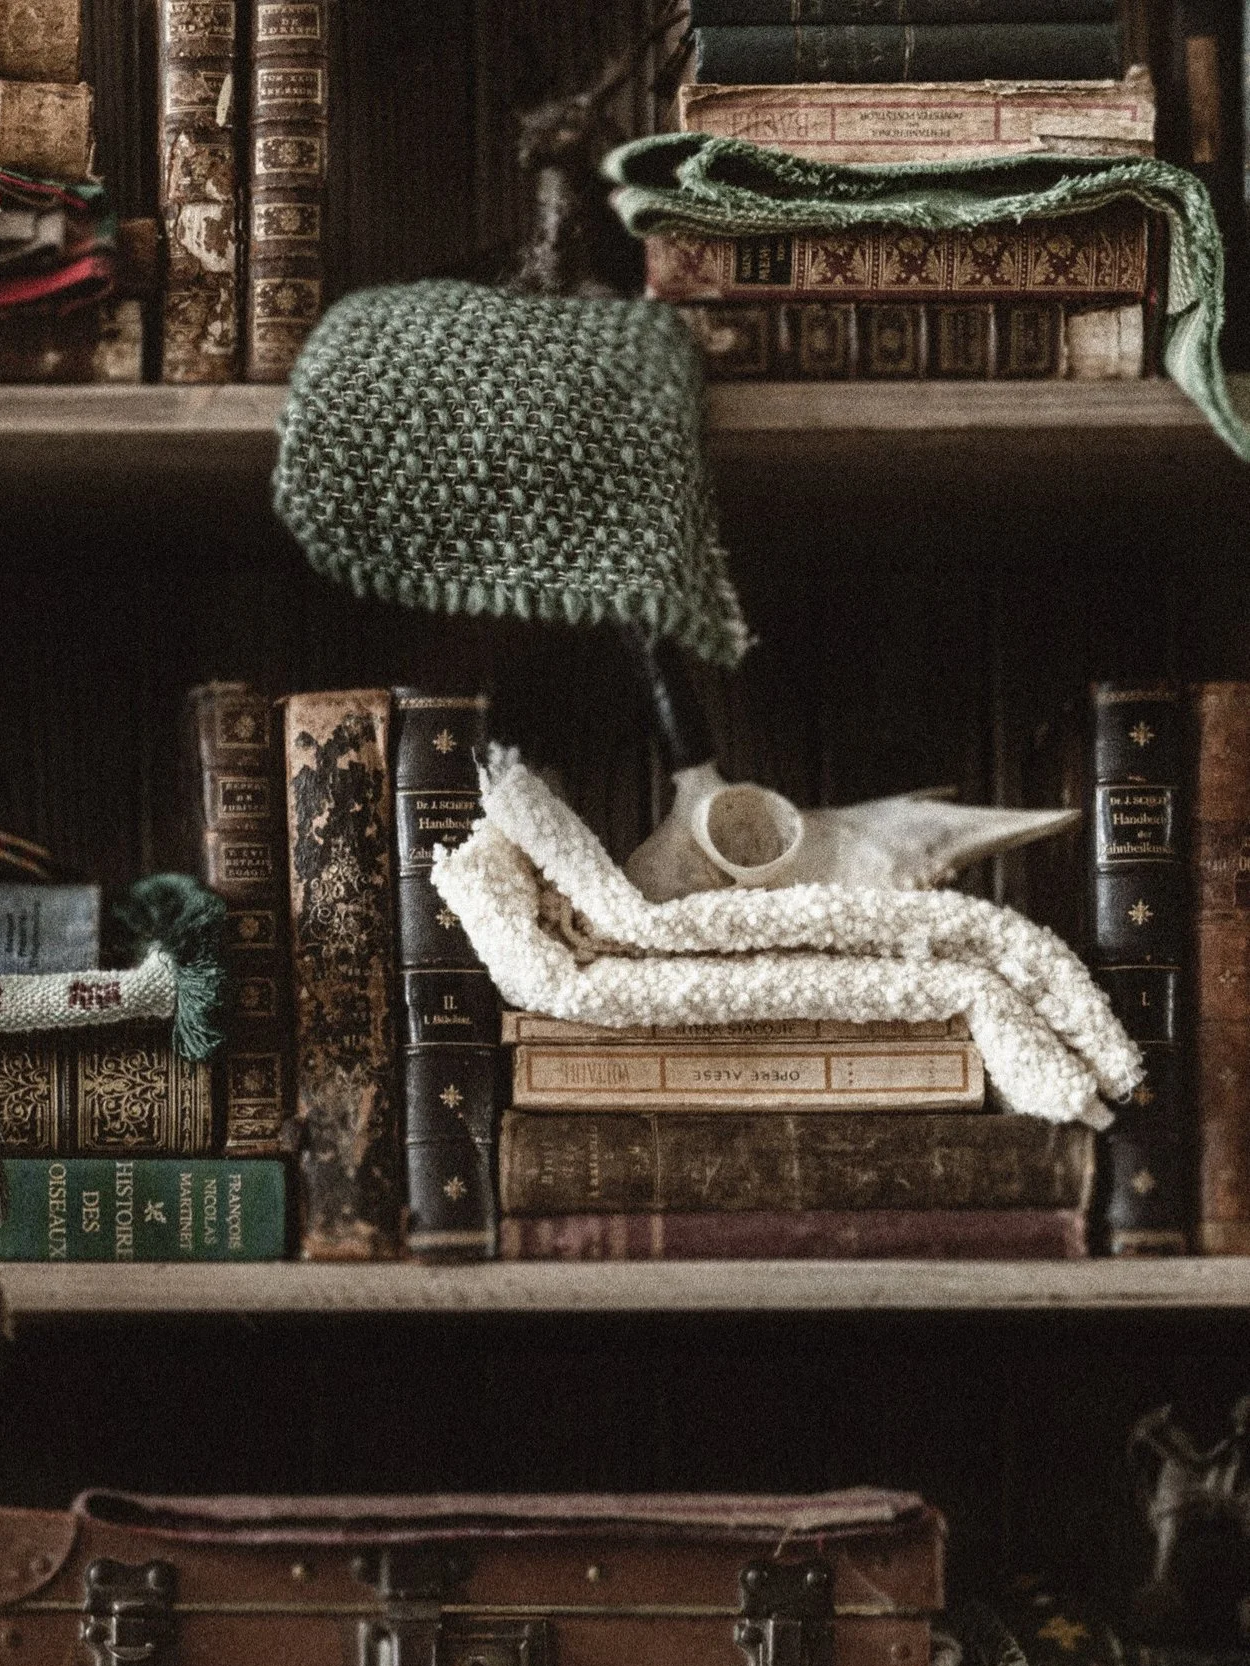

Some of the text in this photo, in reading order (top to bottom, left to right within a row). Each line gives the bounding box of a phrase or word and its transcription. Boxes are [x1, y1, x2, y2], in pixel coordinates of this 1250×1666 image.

[409, 847, 434, 859] Zahn
[441, 834, 457, 842] der
[443, 994, 459, 1010] II.
[692, 1069, 800, 1082] OPERE ALESE
[49, 1162, 67, 1258] OISEAUX
[82, 1189, 100, 1233] DES
[116, 1161, 135, 1259] HISTOIRE
[179, 1172, 193, 1250] MARTINET
[203, 1178, 217, 1245] NICOLAS
[227, 1173, 243, 1250] FRANÇOIS
